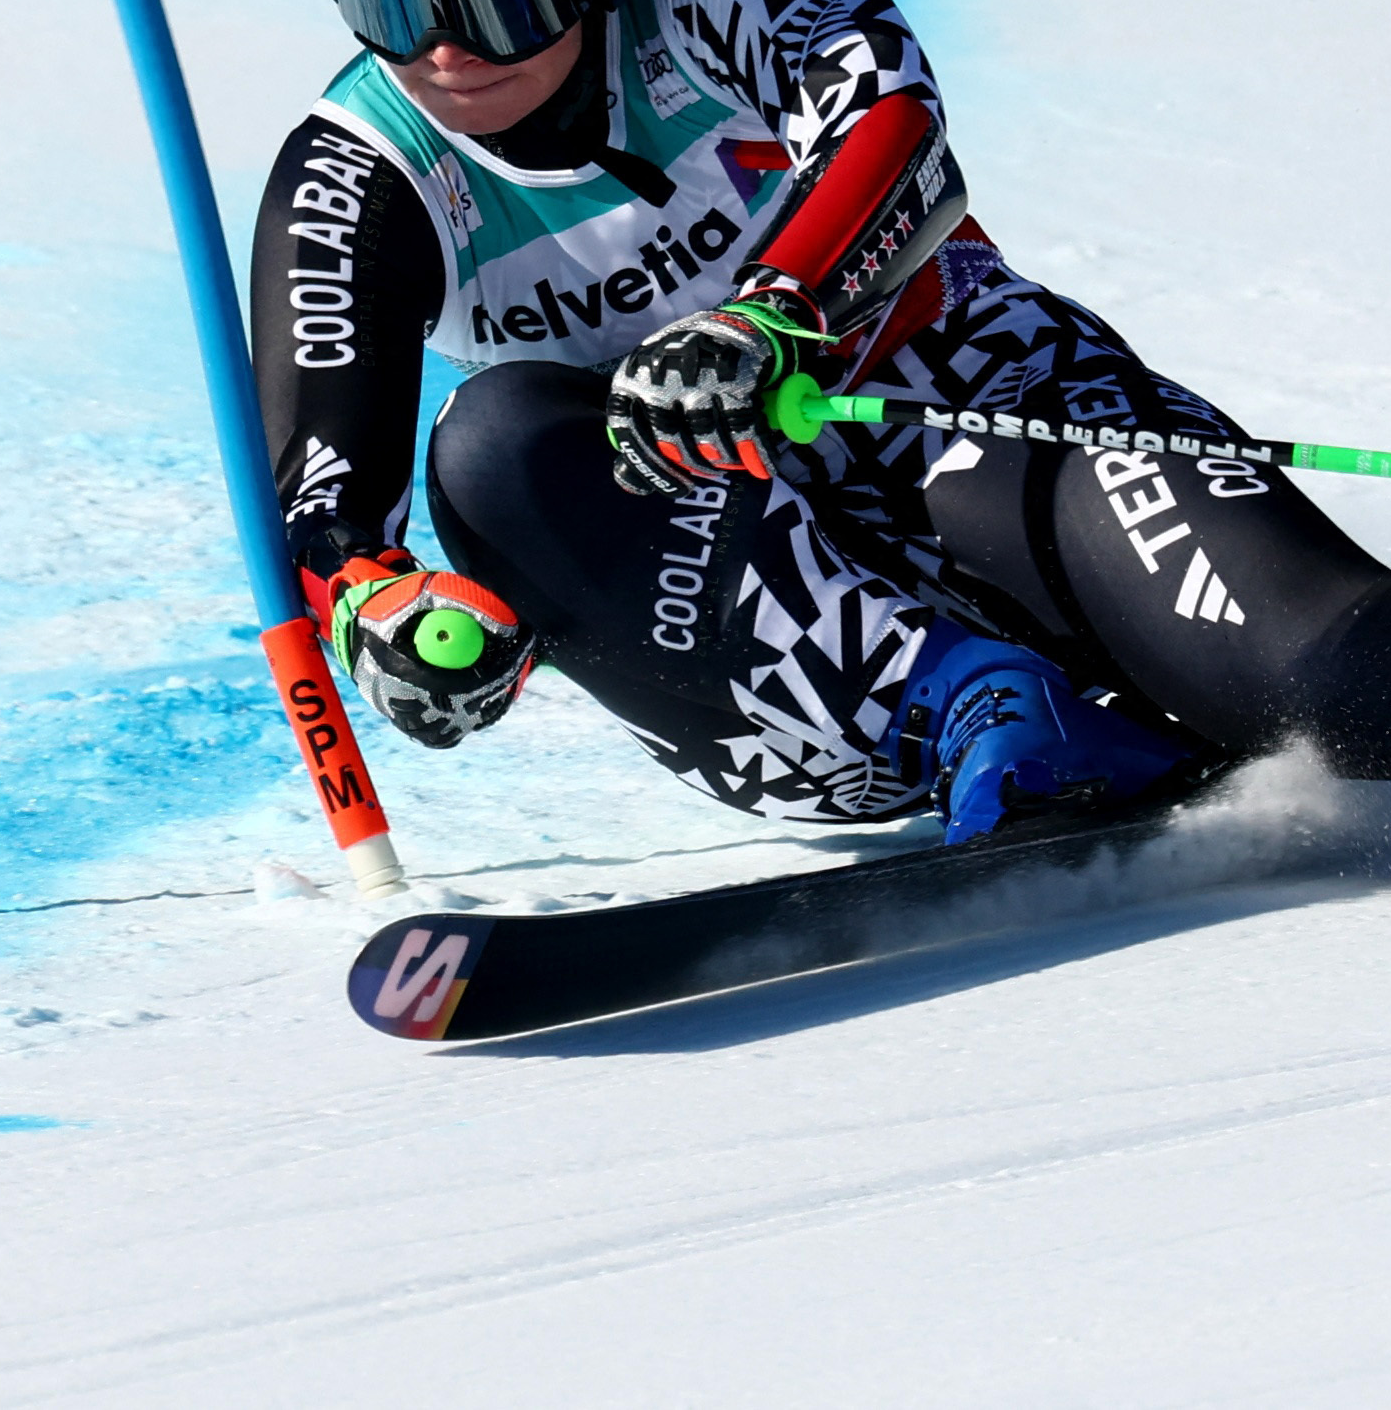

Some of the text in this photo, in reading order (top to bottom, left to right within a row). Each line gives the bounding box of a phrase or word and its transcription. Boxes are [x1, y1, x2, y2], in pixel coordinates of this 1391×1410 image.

[288, 133, 379, 368] COOLABAH
[472, 207, 742, 345] helvetia
[924, 406, 1272, 463] KOMPERDELL
[289, 679, 364, 814] SPM
